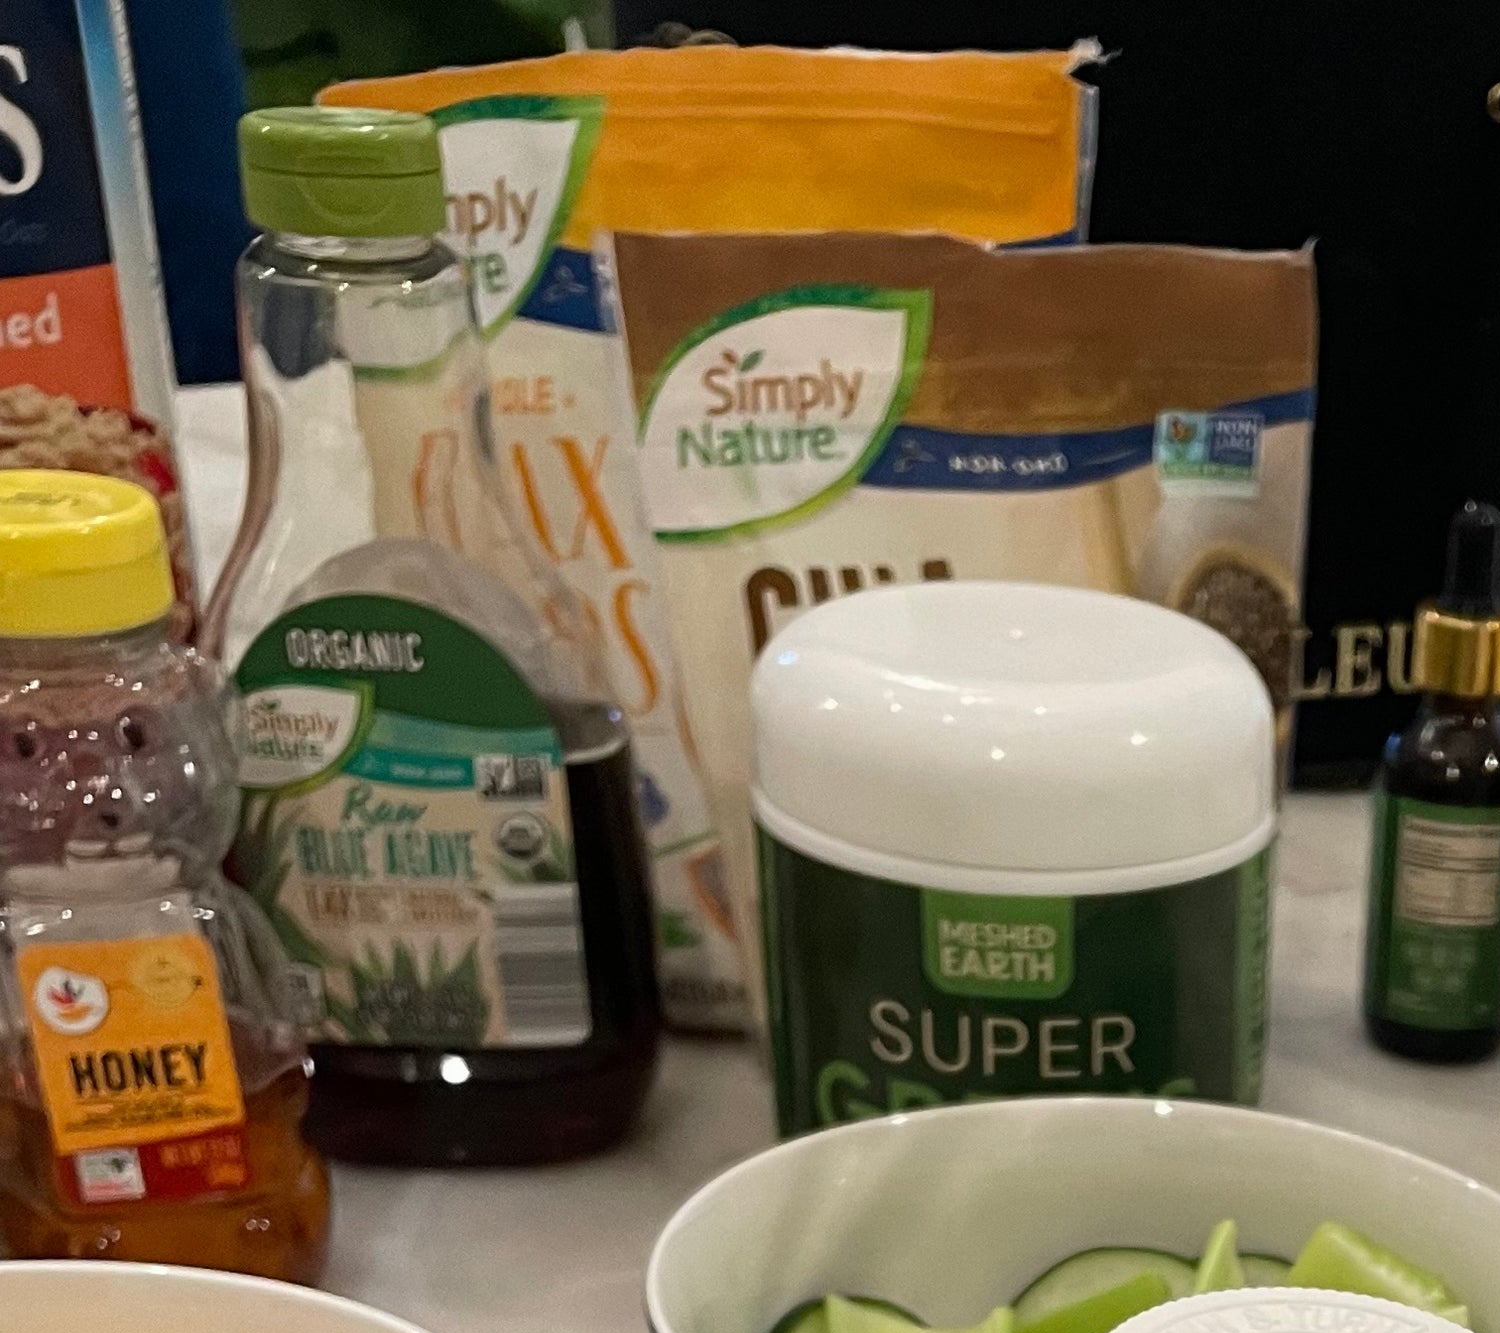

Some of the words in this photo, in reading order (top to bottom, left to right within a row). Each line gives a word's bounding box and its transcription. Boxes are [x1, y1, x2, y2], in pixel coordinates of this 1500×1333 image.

[0, 290, 61, 348] ed
[703, 349, 863, 420] Simply
[677, 421, 836, 468] Nature
[285, 628, 424, 672] ORGANIC
[938, 919, 1056, 950] MESHED
[938, 949, 1055, 983] EARTH
[869, 1000, 1136, 1079] SUPER
[69, 1042, 208, 1096] HONEY
